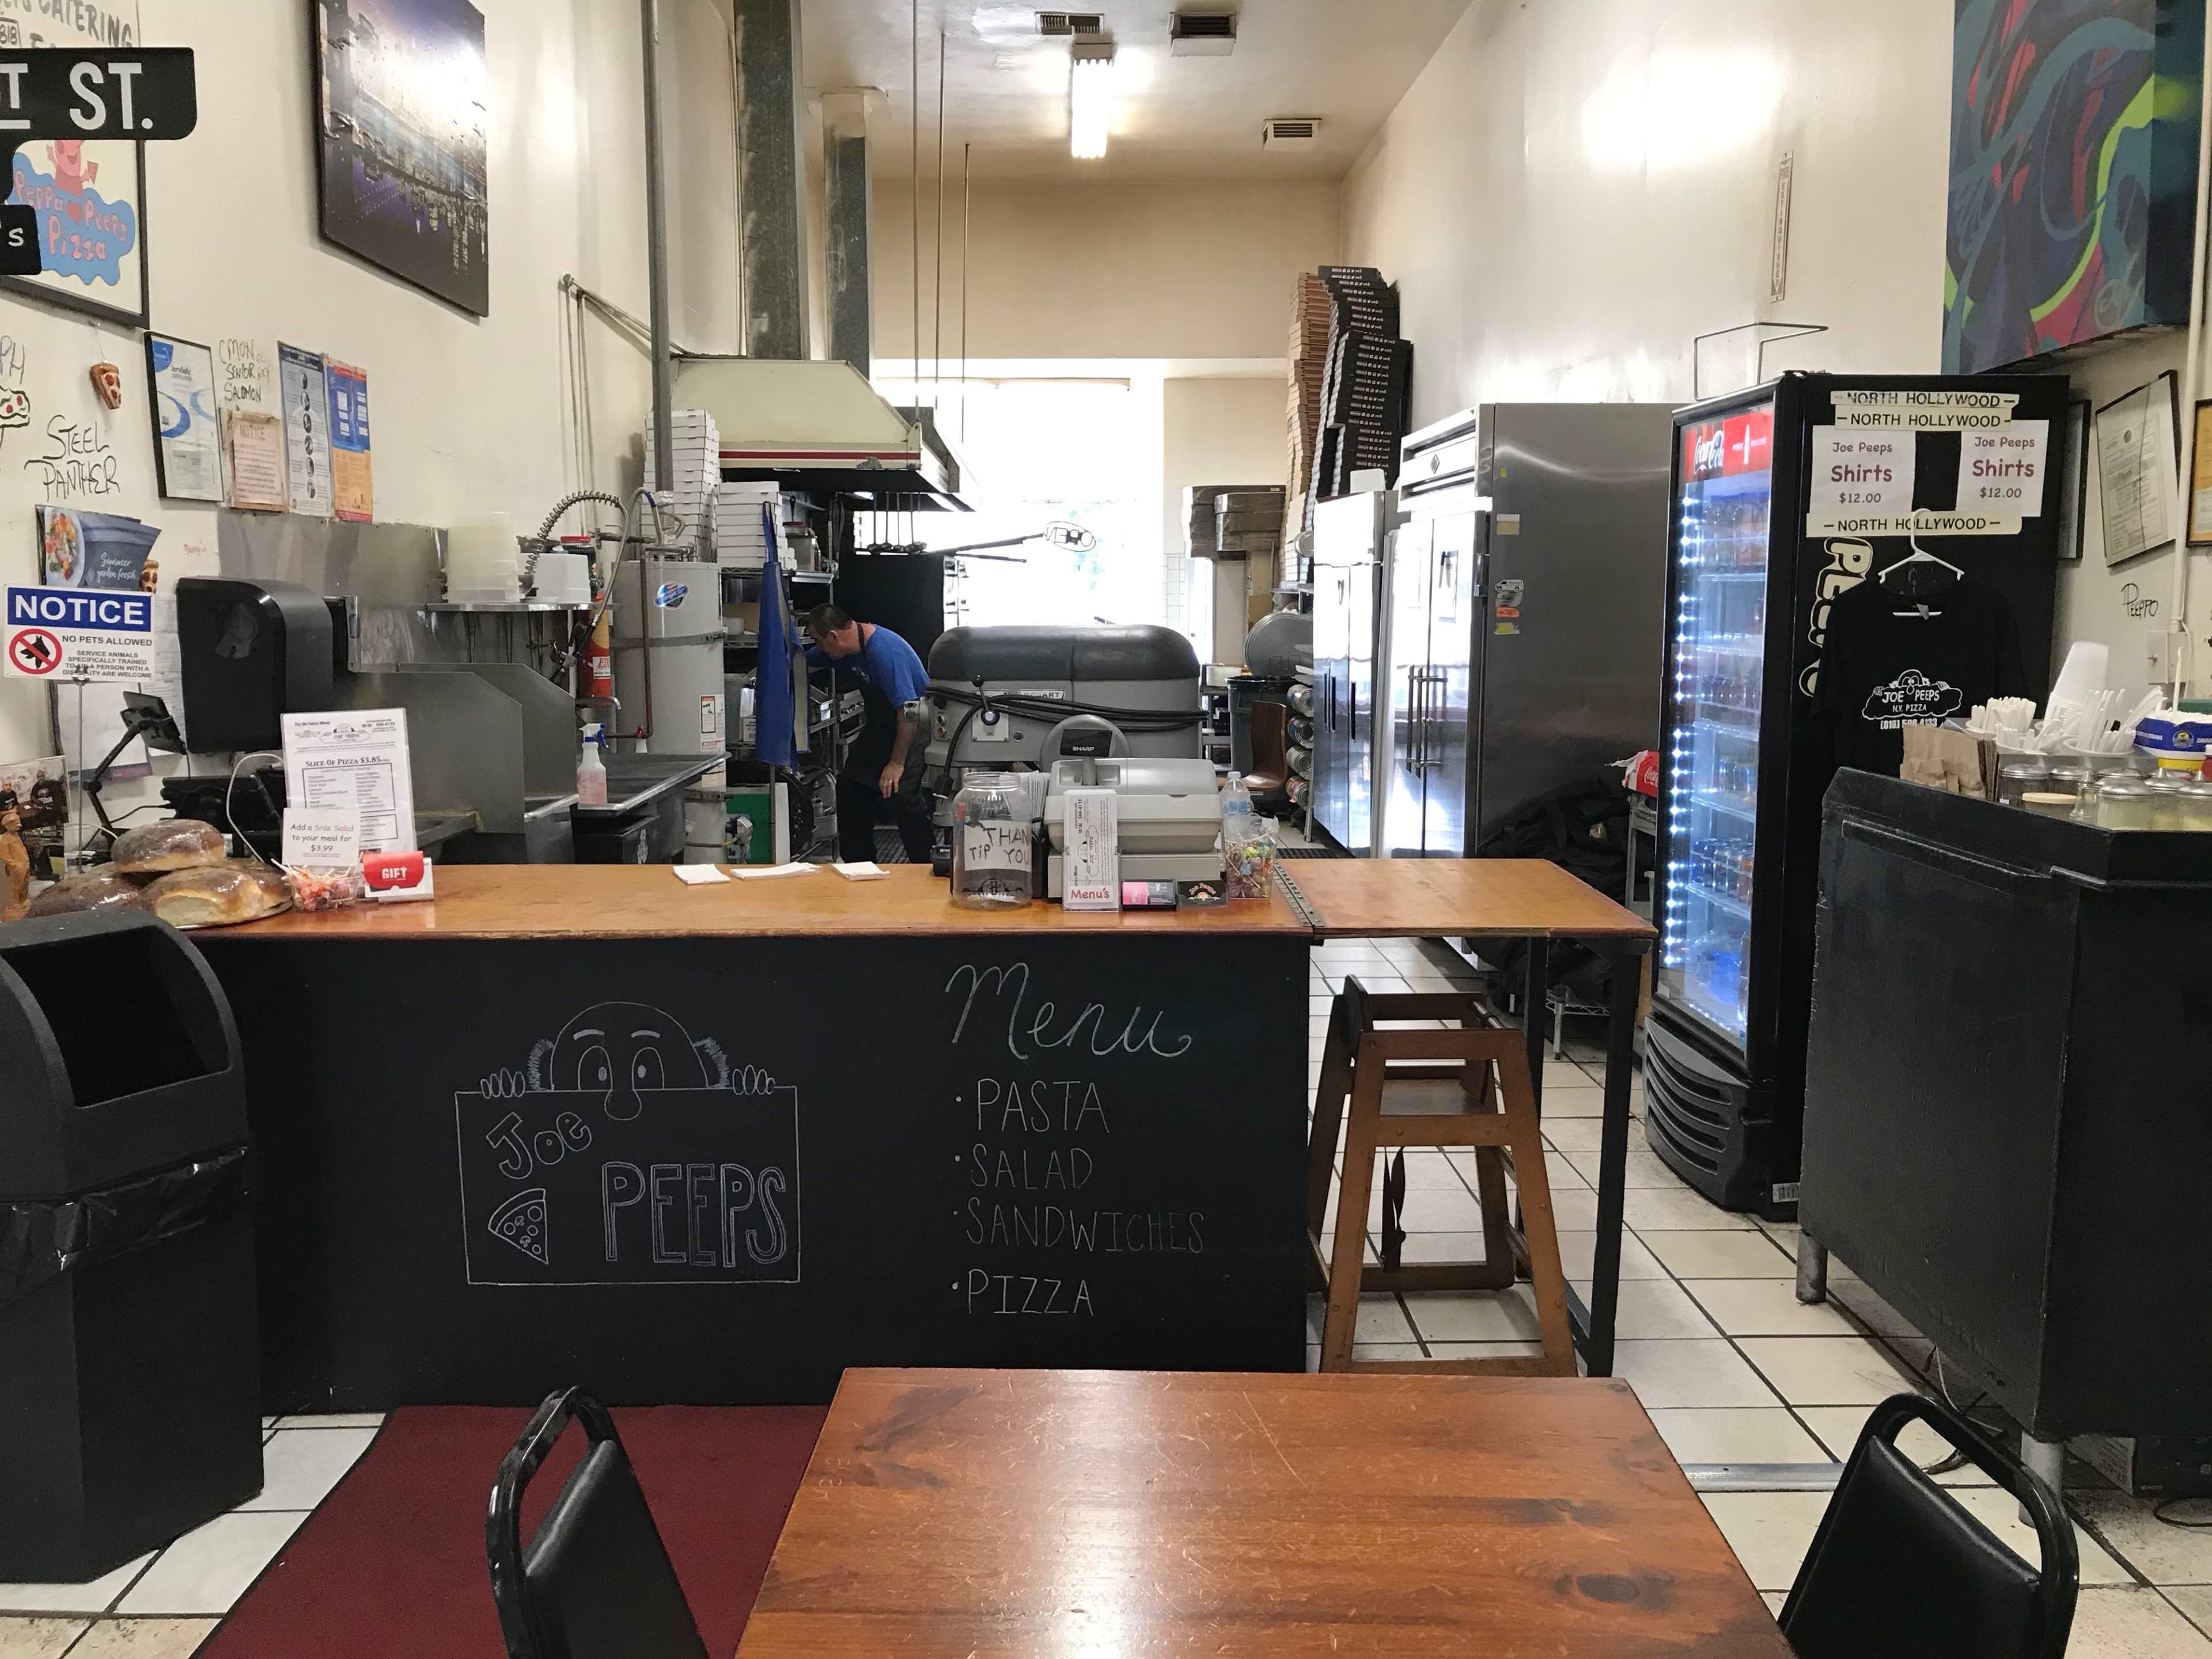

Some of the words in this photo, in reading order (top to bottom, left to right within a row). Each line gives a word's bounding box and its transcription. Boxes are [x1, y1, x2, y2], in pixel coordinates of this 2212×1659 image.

[69, 62, 153, 130] ST.
[48, 215, 107, 260] Pizza
[1847, 392, 1898, 404] NORTH
[1906, 392, 2000, 407] HOLLYWOOD
[1850, 414, 1900, 426] NORTH
[1908, 414, 2001, 427] HOLLYWOOD
[43, 414, 109, 460] STEEL
[1975, 437, 1995, 448] Joe
[2000, 437, 2035, 450] Peeps
[1832, 442, 1853, 452] Joe
[1859, 442, 1892, 456] Peeps
[1831, 464, 1892, 483] Shirts
[1972, 459, 2035, 478] Shirts
[24, 455, 121, 502] PANTHER
[1839, 491, 1881, 505] $12.00
[1980, 486, 2021, 498] $12.00
[1838, 518, 1887, 532] NORTH
[1896, 518, 1986, 530] HOLLYWOOD
[16, 594, 143, 625] NOTICE
[79, 636, 104, 644] PETS
[106, 638, 152, 646] ALLOWED
[1881, 691, 1904, 703] JOE
[1915, 690, 1940, 701] PEEPS
[1906, 704, 1927, 712] PIZZA
[360, 756, 381, 764] $3.85
[1003, 848, 1029, 865] YOU
[382, 867, 408, 879] GIFT
[1071, 887, 1109, 900] Menu's
[945, 962, 1192, 1060] Menu
[978, 1078, 1109, 1133] PASTA
[486, 1112, 592, 1180] Joe
[971, 1143, 1092, 1190] SALAD
[601, 1161, 786, 1268] PEEPS
[967, 1196, 1204, 1253] SANDWICHES
[968, 1268, 1093, 1316] PIZZA
